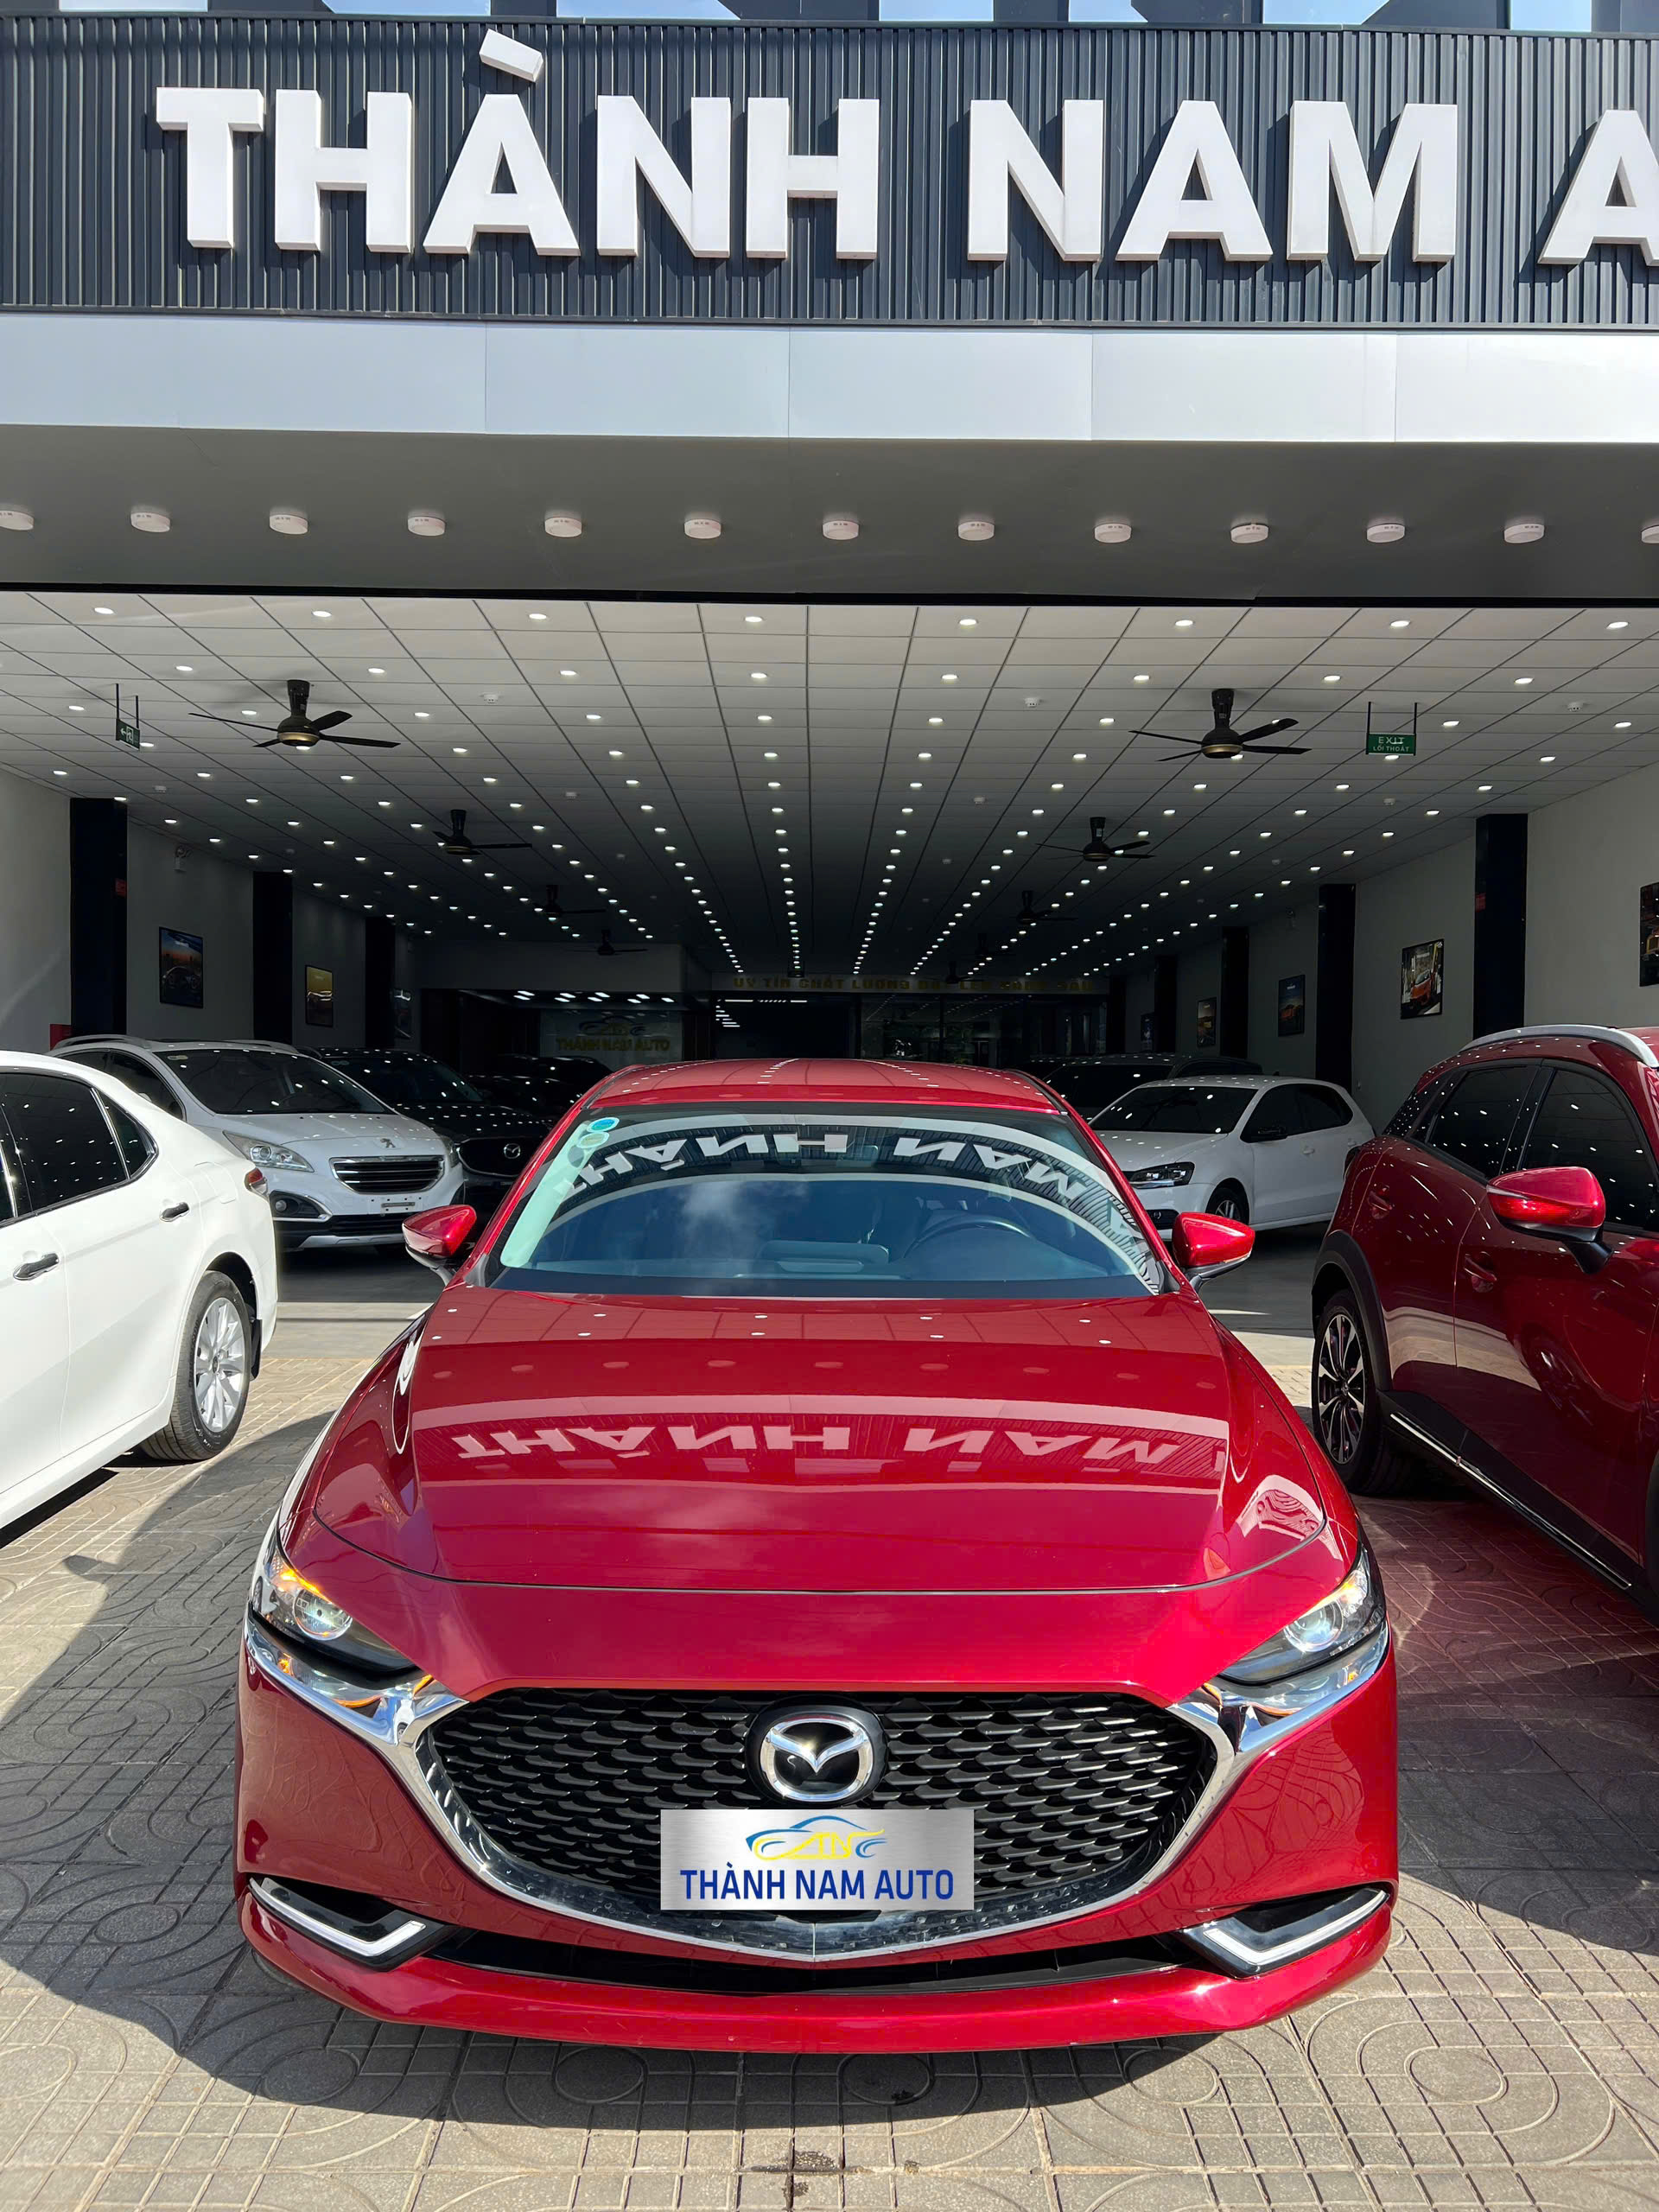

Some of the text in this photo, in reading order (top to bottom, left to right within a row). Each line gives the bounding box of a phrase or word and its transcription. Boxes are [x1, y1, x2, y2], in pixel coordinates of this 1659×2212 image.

[156, 29, 880, 261] THÀNH
[967, 99, 1458, 264] NAM
[1378, 736, 1404, 745] EXIT
